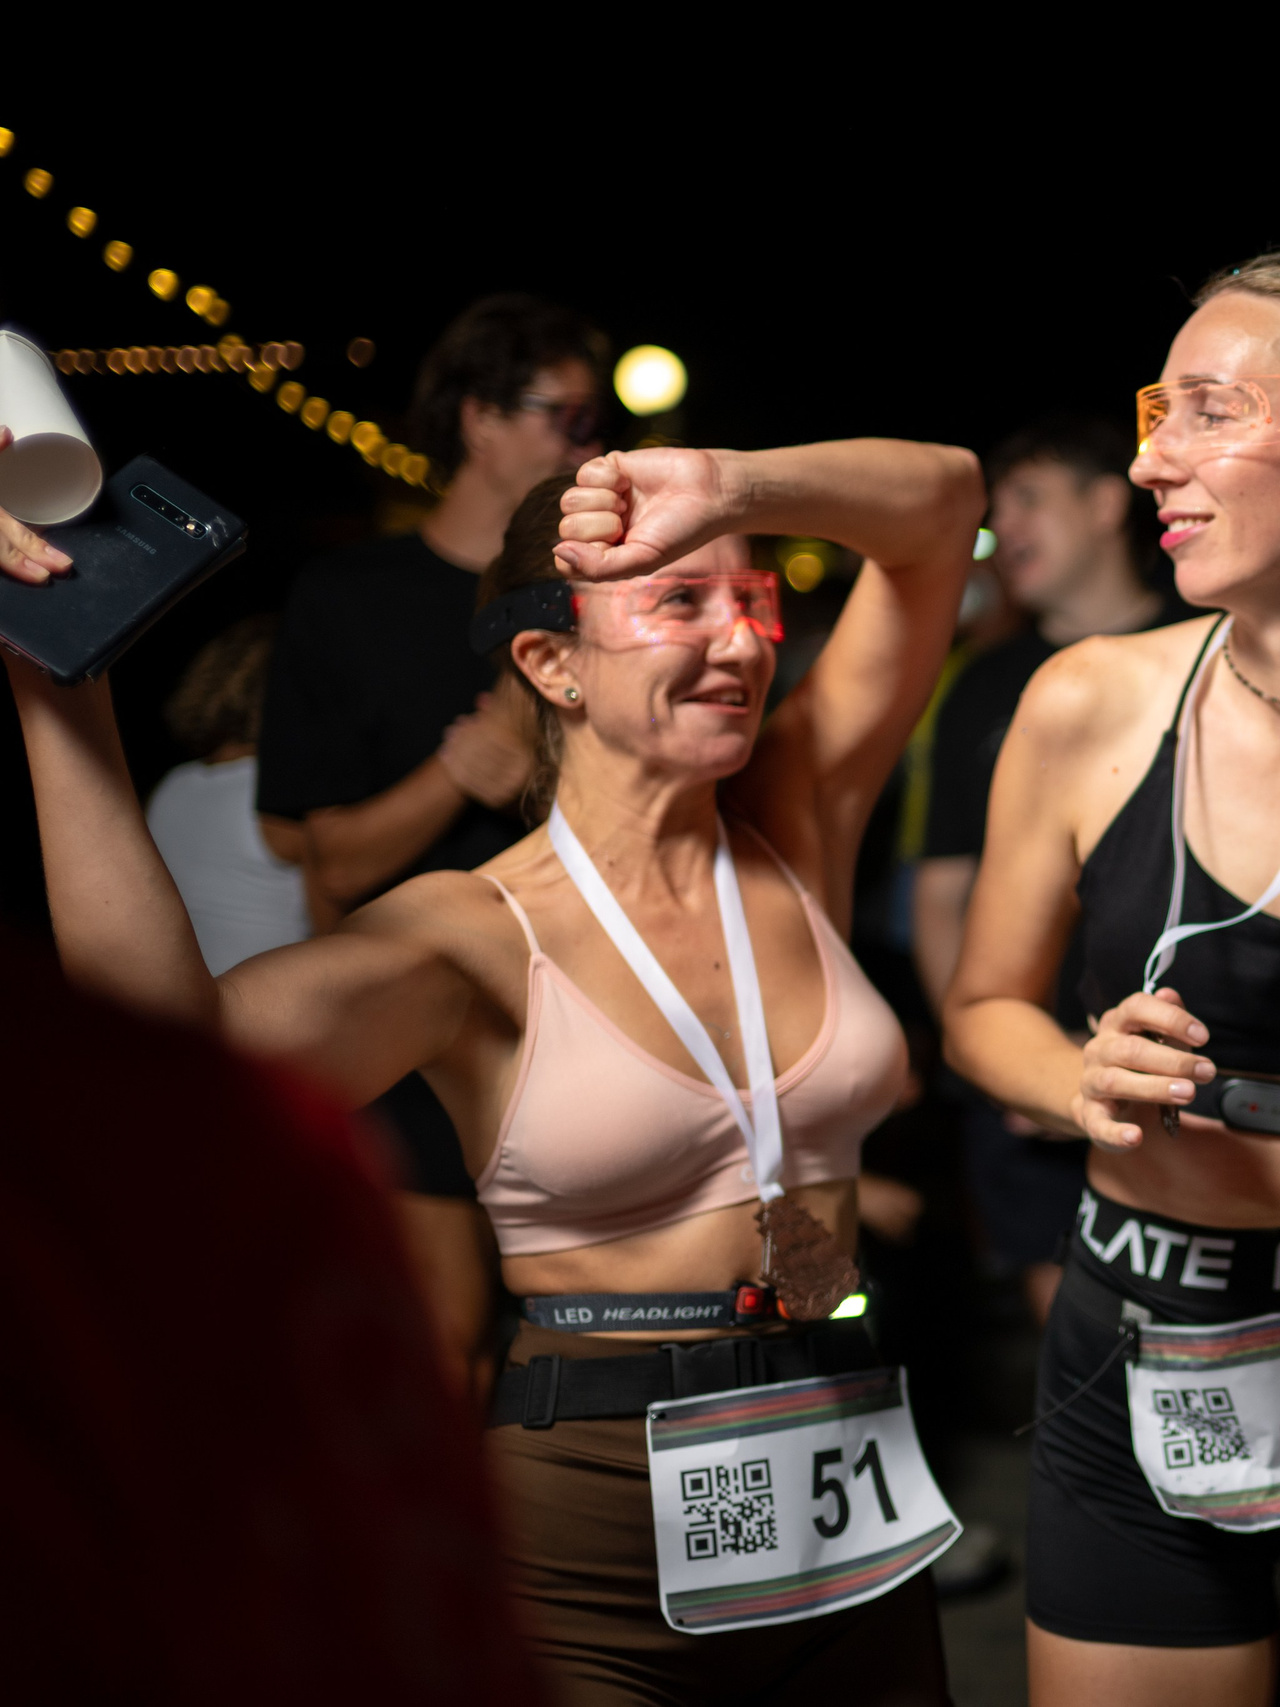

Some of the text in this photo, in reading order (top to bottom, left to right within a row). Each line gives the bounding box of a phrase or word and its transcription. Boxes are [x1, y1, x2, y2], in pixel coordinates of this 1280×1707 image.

[115, 525, 157, 555] SAMSUNG
[554, 1307, 593, 1325] LED
[602, 1305, 724, 1323] HEADLIGHT
[812, 1439, 900, 1539] 51
